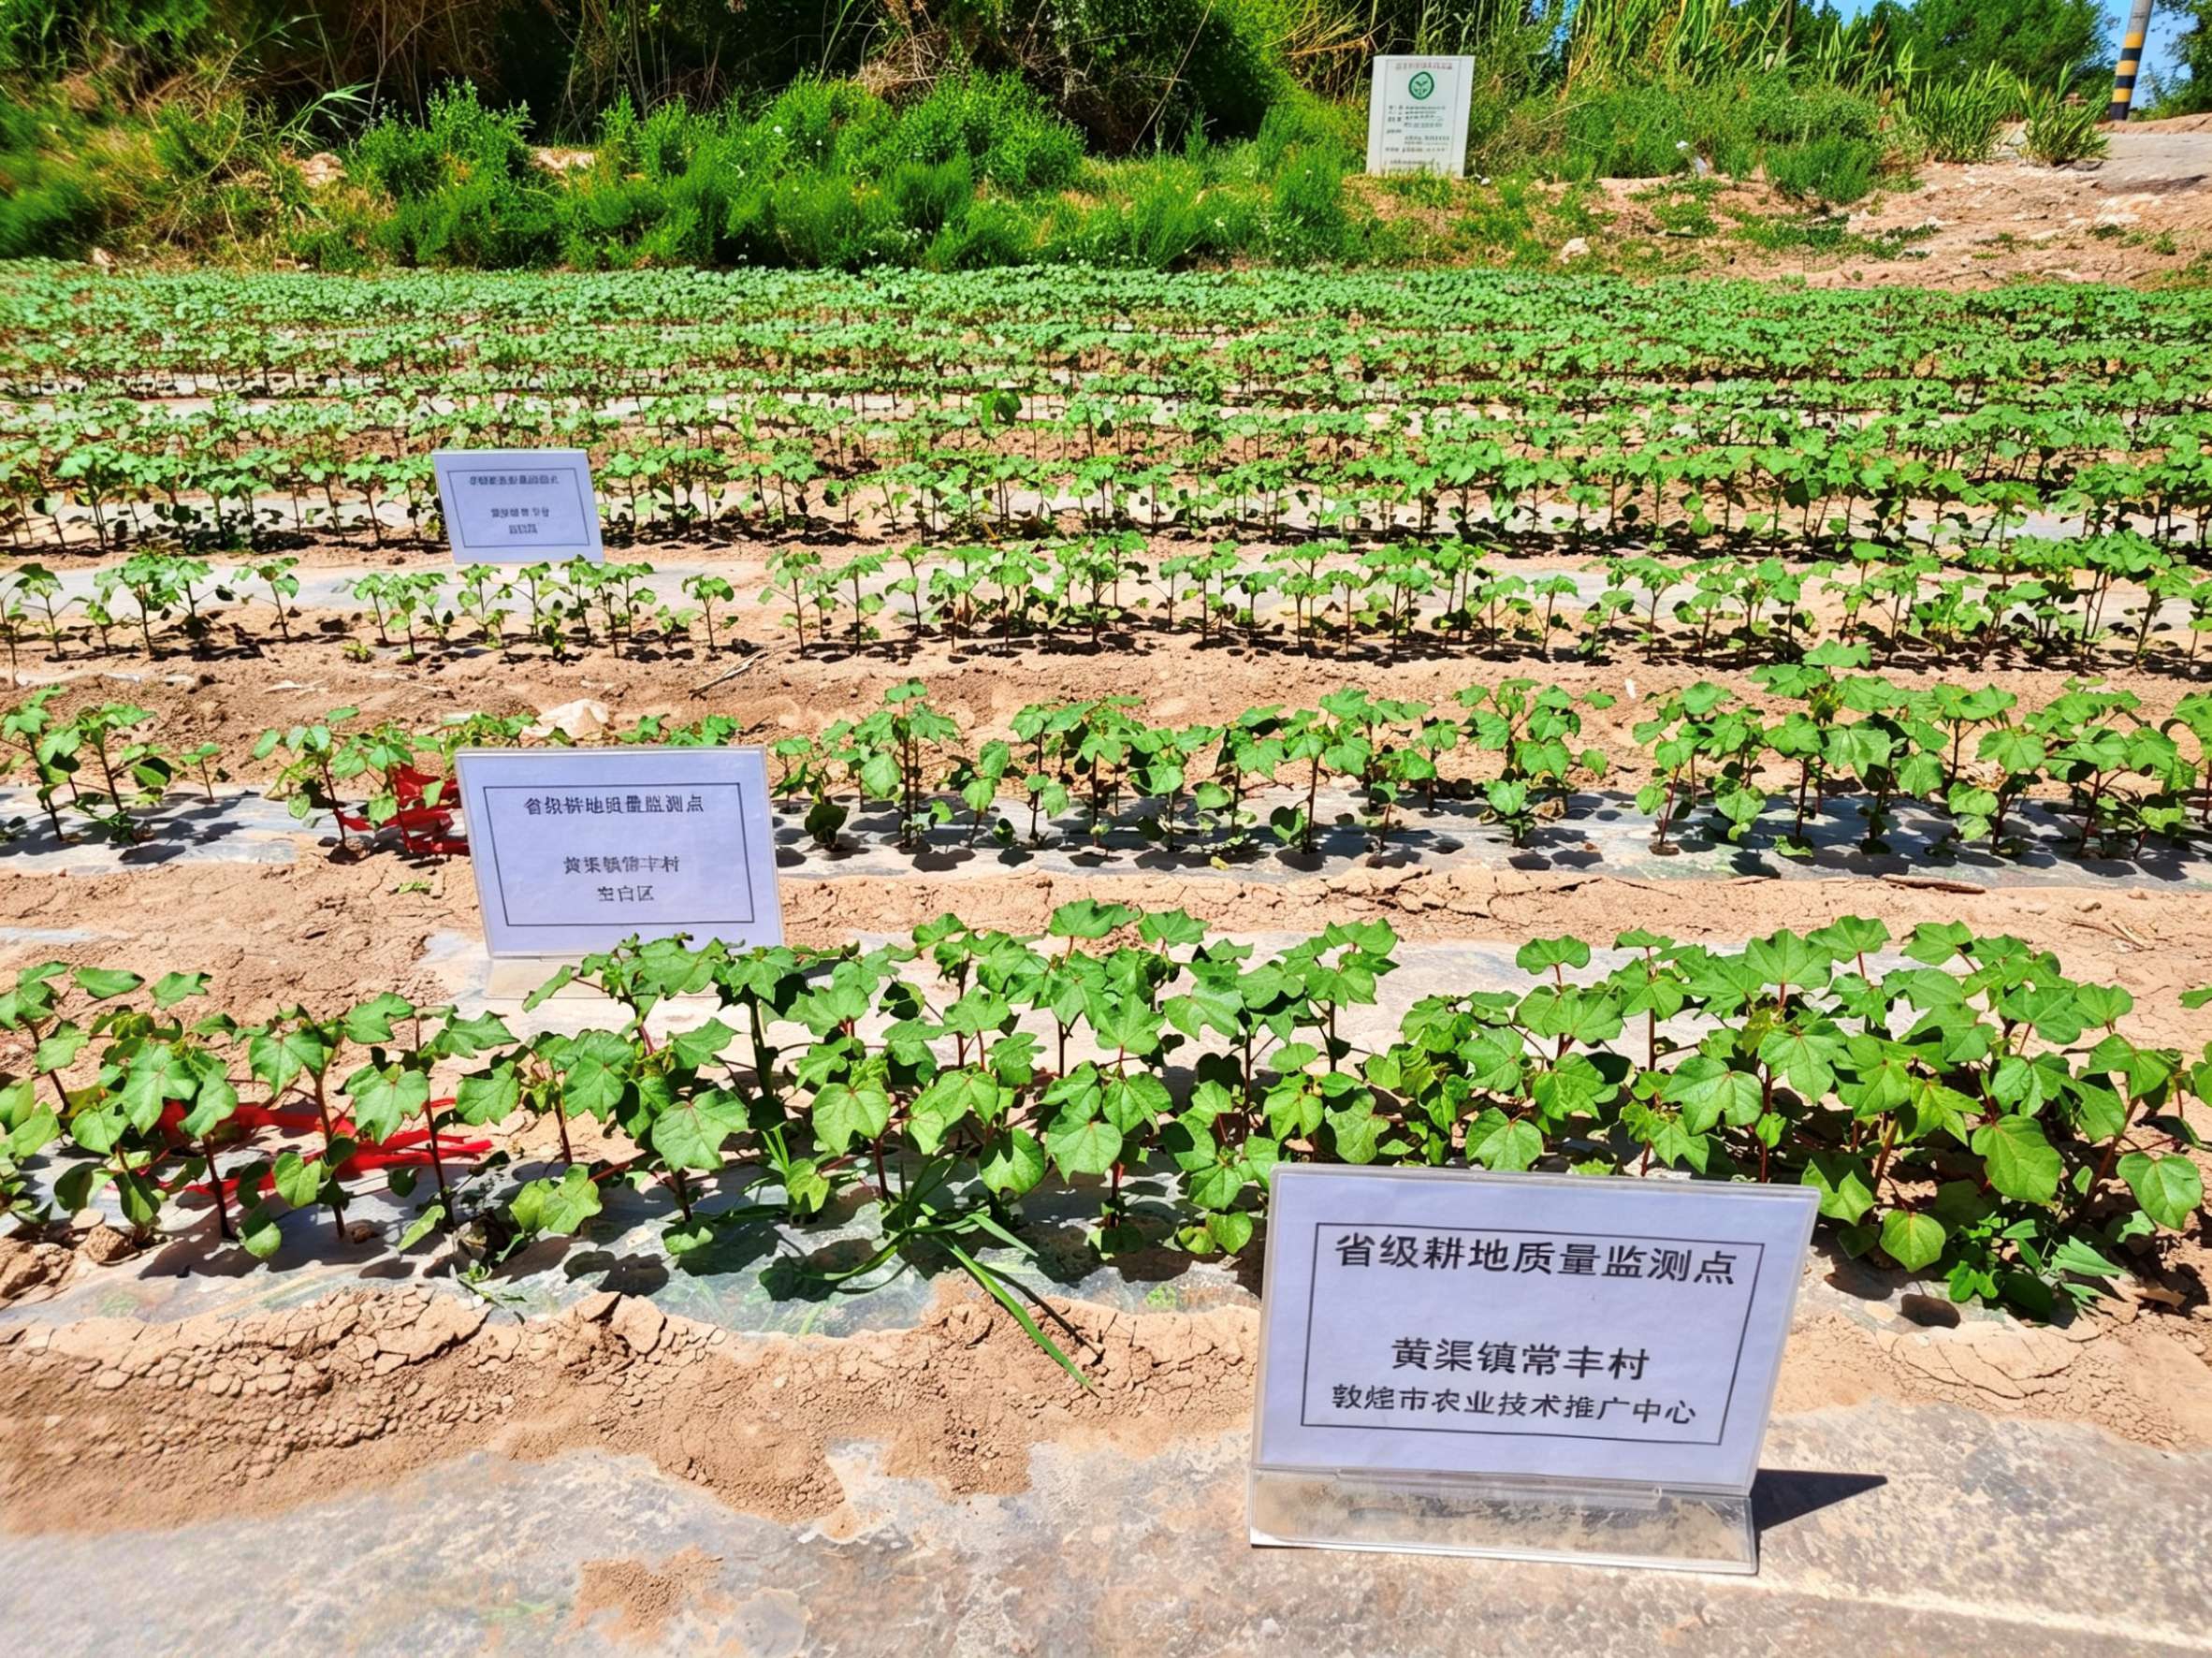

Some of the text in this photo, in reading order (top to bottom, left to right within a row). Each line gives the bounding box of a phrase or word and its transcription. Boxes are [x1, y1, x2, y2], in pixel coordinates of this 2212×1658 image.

[1334, 1232, 1738, 1286] 省级耕地质量监测点
[1390, 1336, 1651, 1381] 黄渠镇常丰村
[1331, 1383, 1697, 1426] 敦煌市农业技术推广中心
